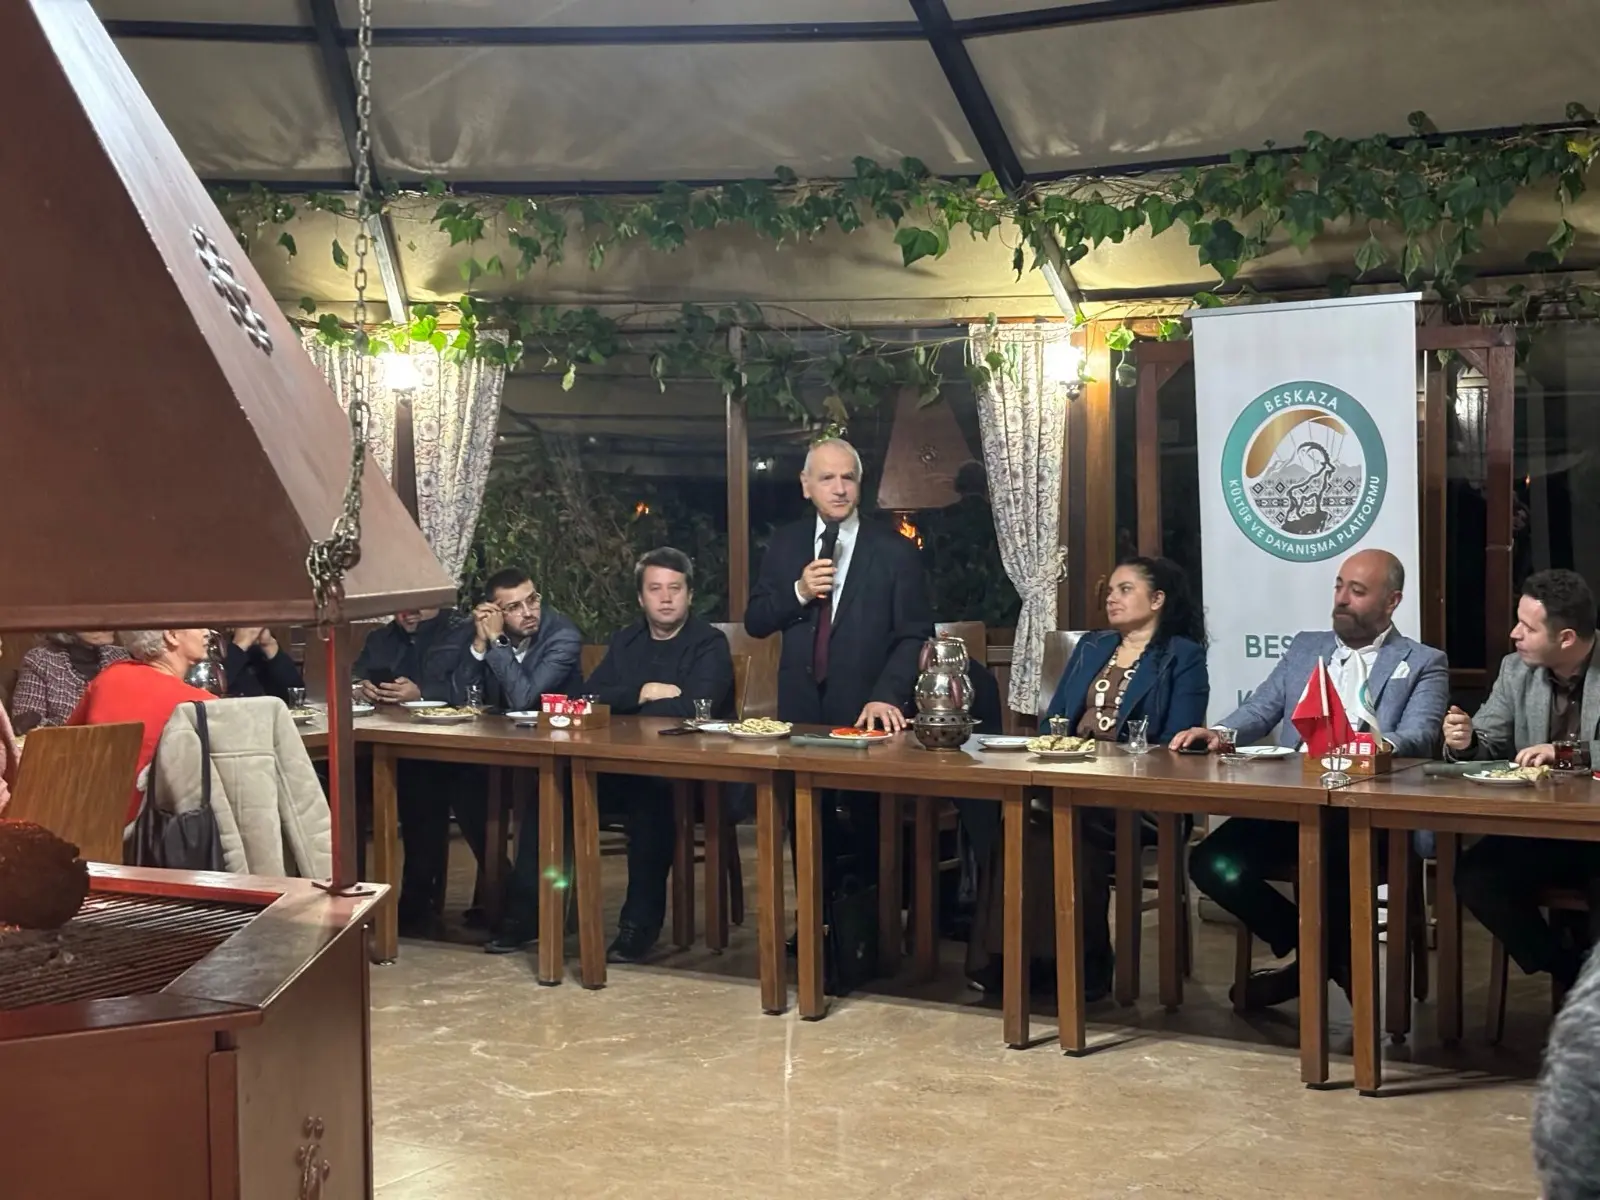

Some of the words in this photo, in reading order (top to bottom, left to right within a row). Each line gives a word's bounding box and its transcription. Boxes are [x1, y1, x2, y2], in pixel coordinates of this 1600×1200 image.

[1264, 389, 1338, 413] BEŞKAZA
[1229, 479, 1252, 524] KÜLTÜR
[1251, 522, 1266, 538] VE
[1265, 534, 1337, 557] DAYANIŞMA
[1336, 476, 1380, 543] PLATFORMU
